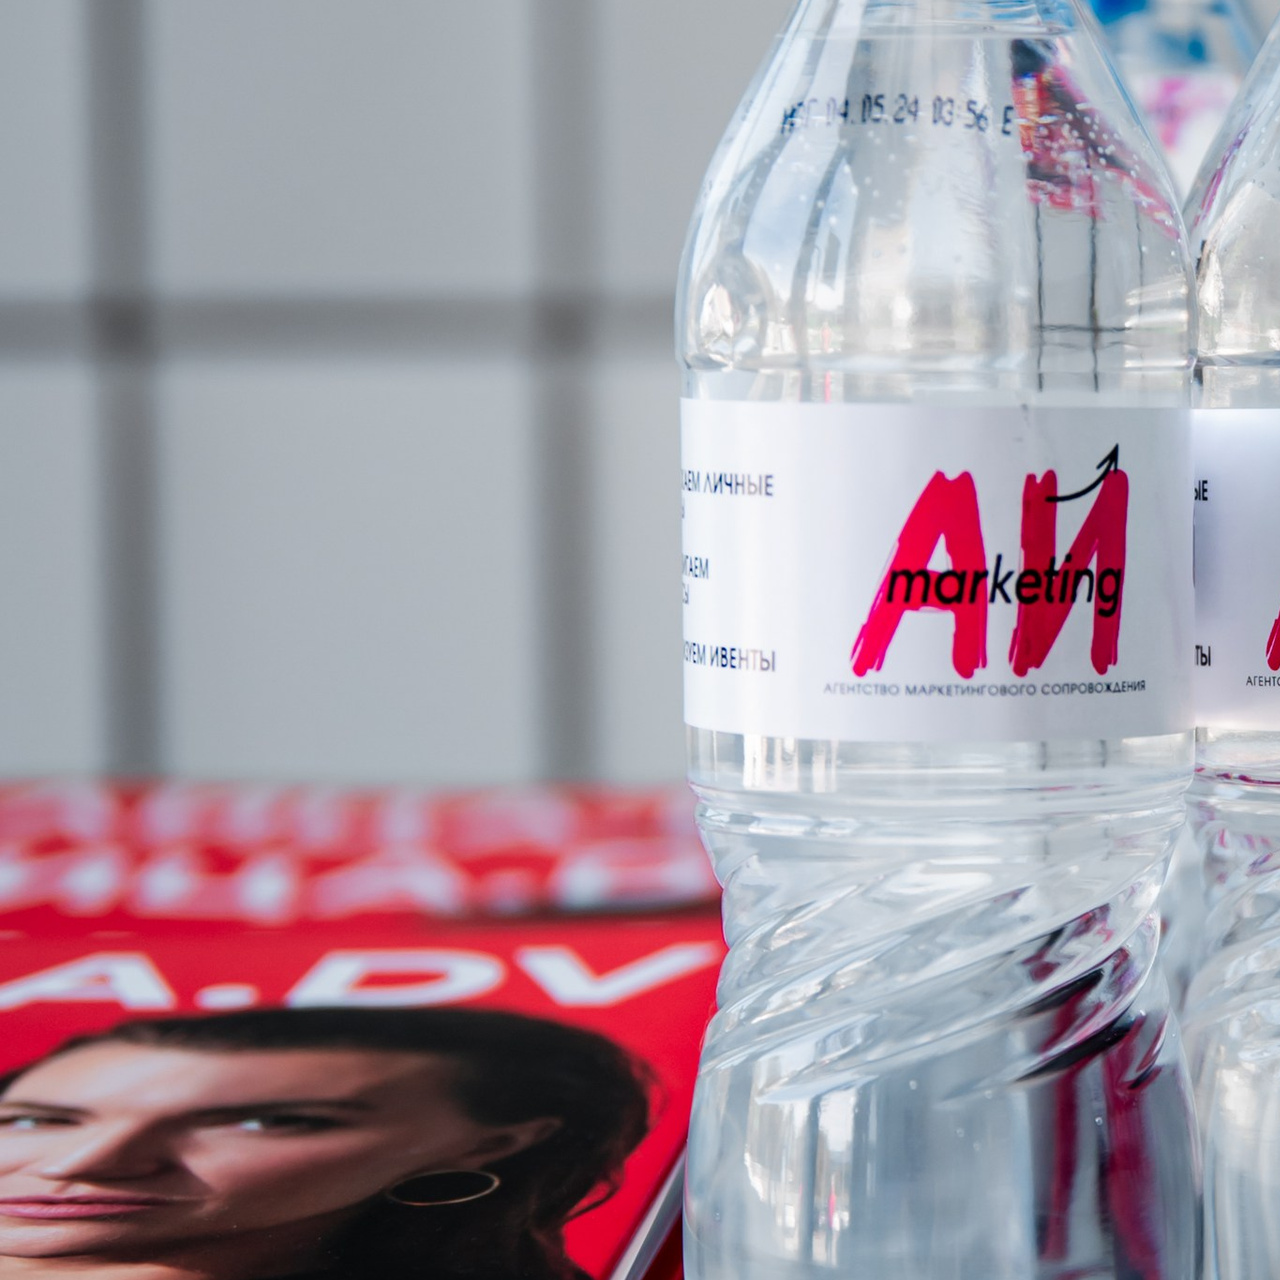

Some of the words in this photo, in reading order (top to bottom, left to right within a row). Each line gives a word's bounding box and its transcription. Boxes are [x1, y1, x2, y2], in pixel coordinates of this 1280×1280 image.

[704, 472, 774, 496] ЛИЧНЫЕ
[886, 554, 1122, 617] marketing
[710, 646, 776, 672] ИВЕНТЫ
[823, 683, 900, 695] АГЕНТСТВО
[905, 683, 1037, 696] МАРКЕТИНГОВОГО
[1041, 680, 1146, 696] СОПРОВОЖДЕНИЯ
